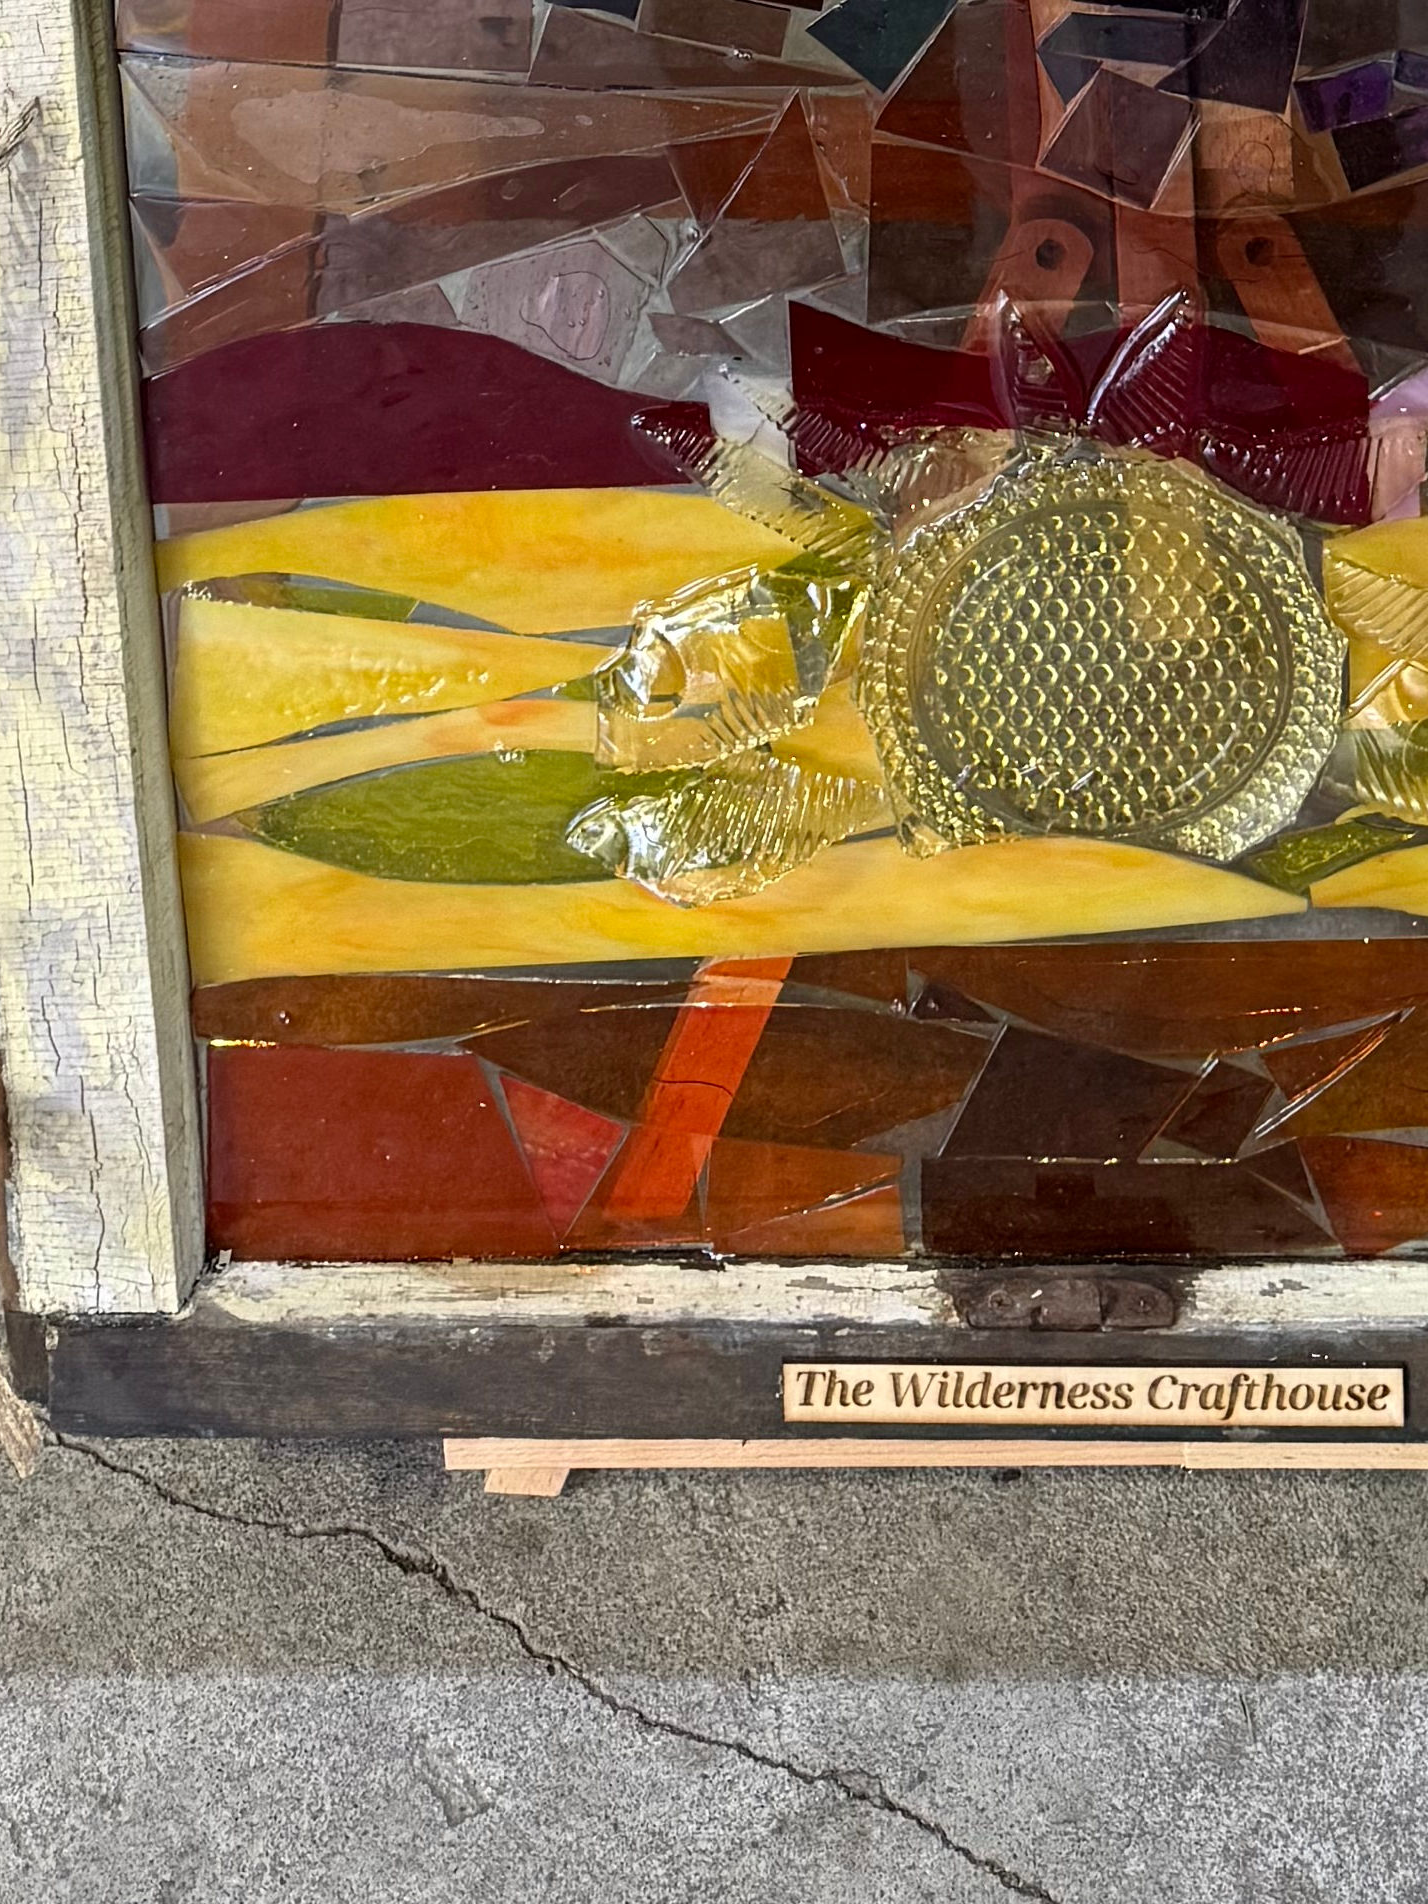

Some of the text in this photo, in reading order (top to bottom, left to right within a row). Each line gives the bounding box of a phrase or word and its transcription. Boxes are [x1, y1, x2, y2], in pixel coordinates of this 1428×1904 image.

[796, 1370, 1391, 1421] The Wilderness Crafthouse
